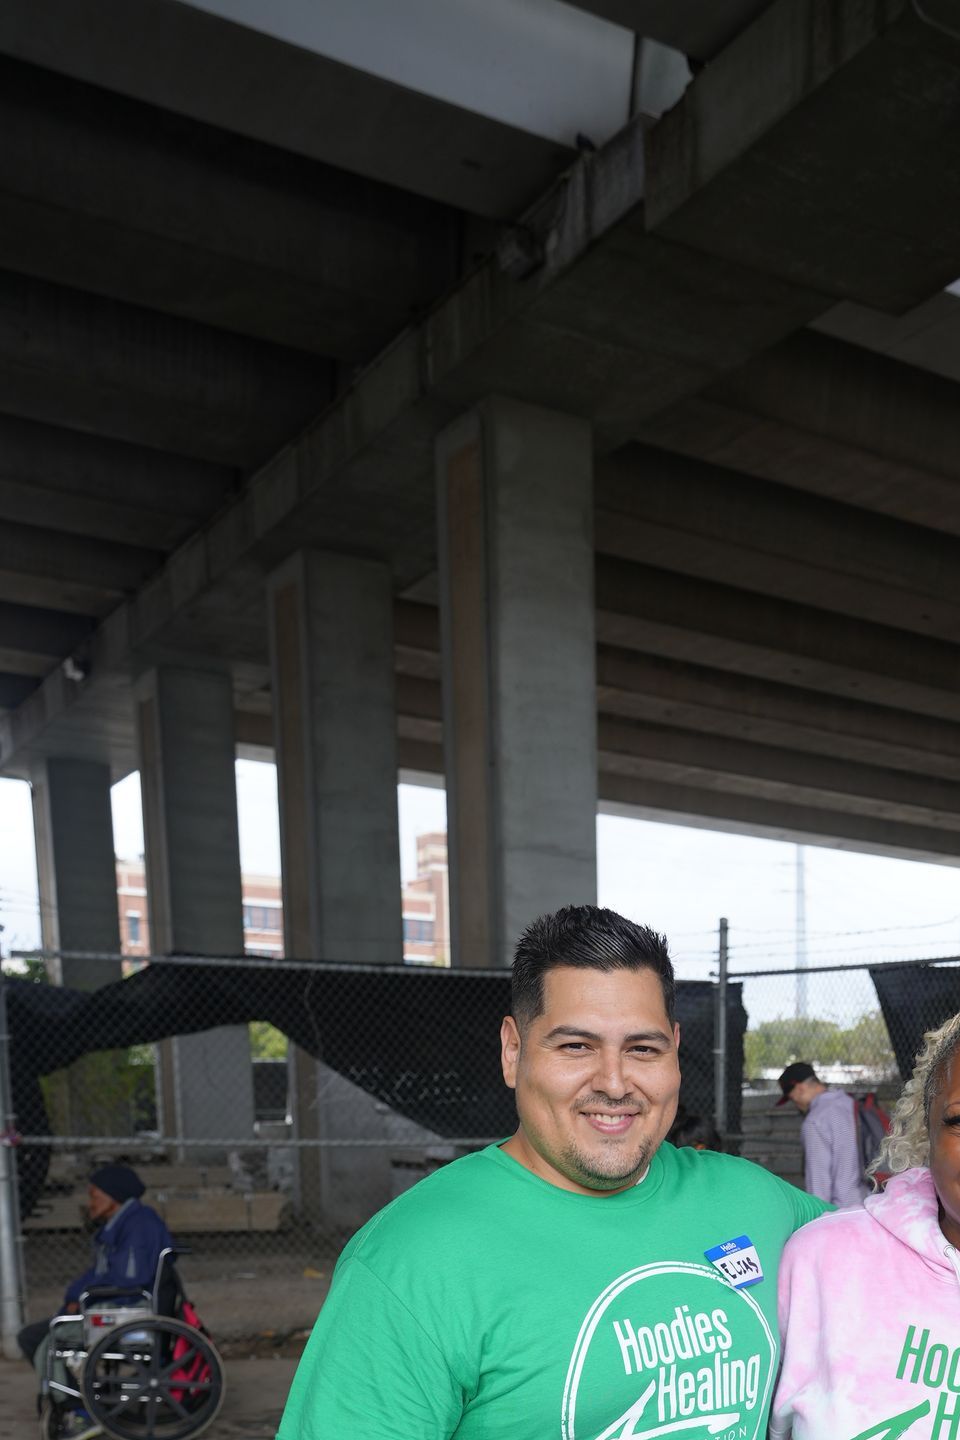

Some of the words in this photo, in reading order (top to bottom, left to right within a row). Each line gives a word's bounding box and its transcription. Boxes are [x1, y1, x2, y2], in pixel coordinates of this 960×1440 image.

[720, 1256, 759, 1280] ELIAS
[612, 1304, 733, 1375] Hoodies
[658, 1350, 761, 1422] Healing
